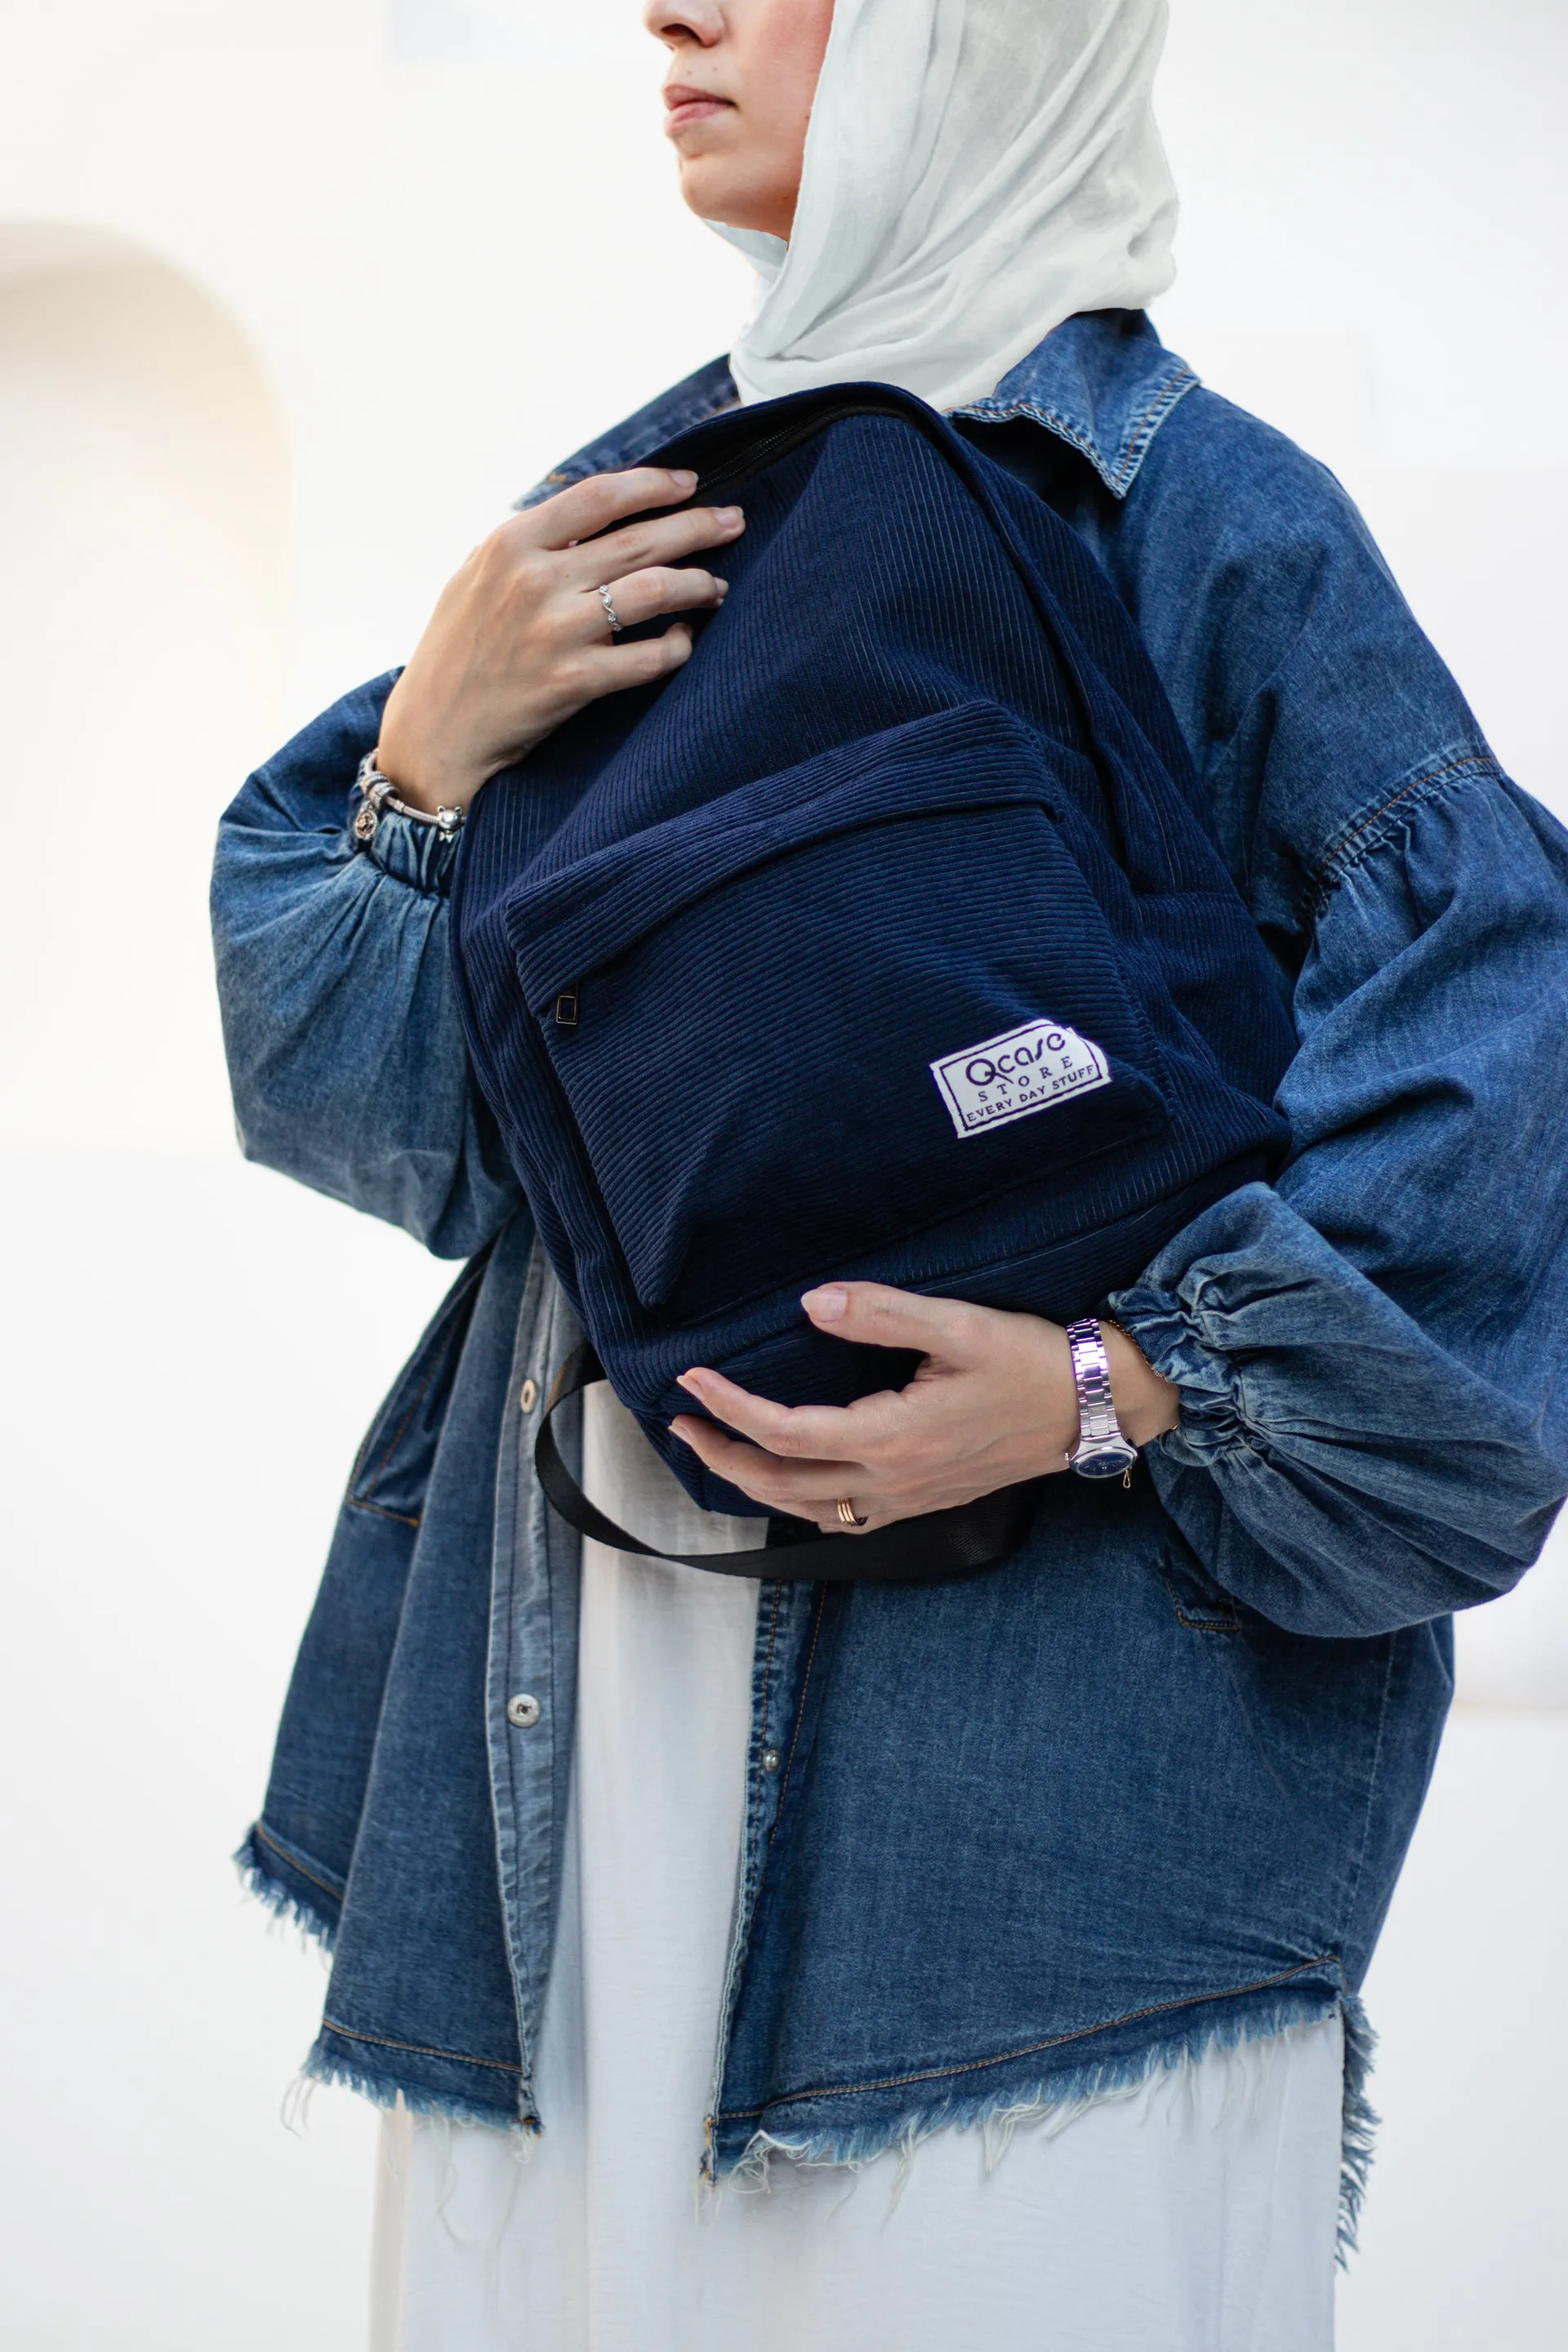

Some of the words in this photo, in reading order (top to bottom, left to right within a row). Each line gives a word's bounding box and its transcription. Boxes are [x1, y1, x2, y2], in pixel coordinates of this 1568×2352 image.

[965, 1033, 1066, 1086] Qcase
[978, 1056, 1072, 1102] STORE
[967, 1098, 1012, 1122] EVERY
[1019, 1085, 1045, 1102] DAY
[1052, 1065, 1094, 1089] STUFF
